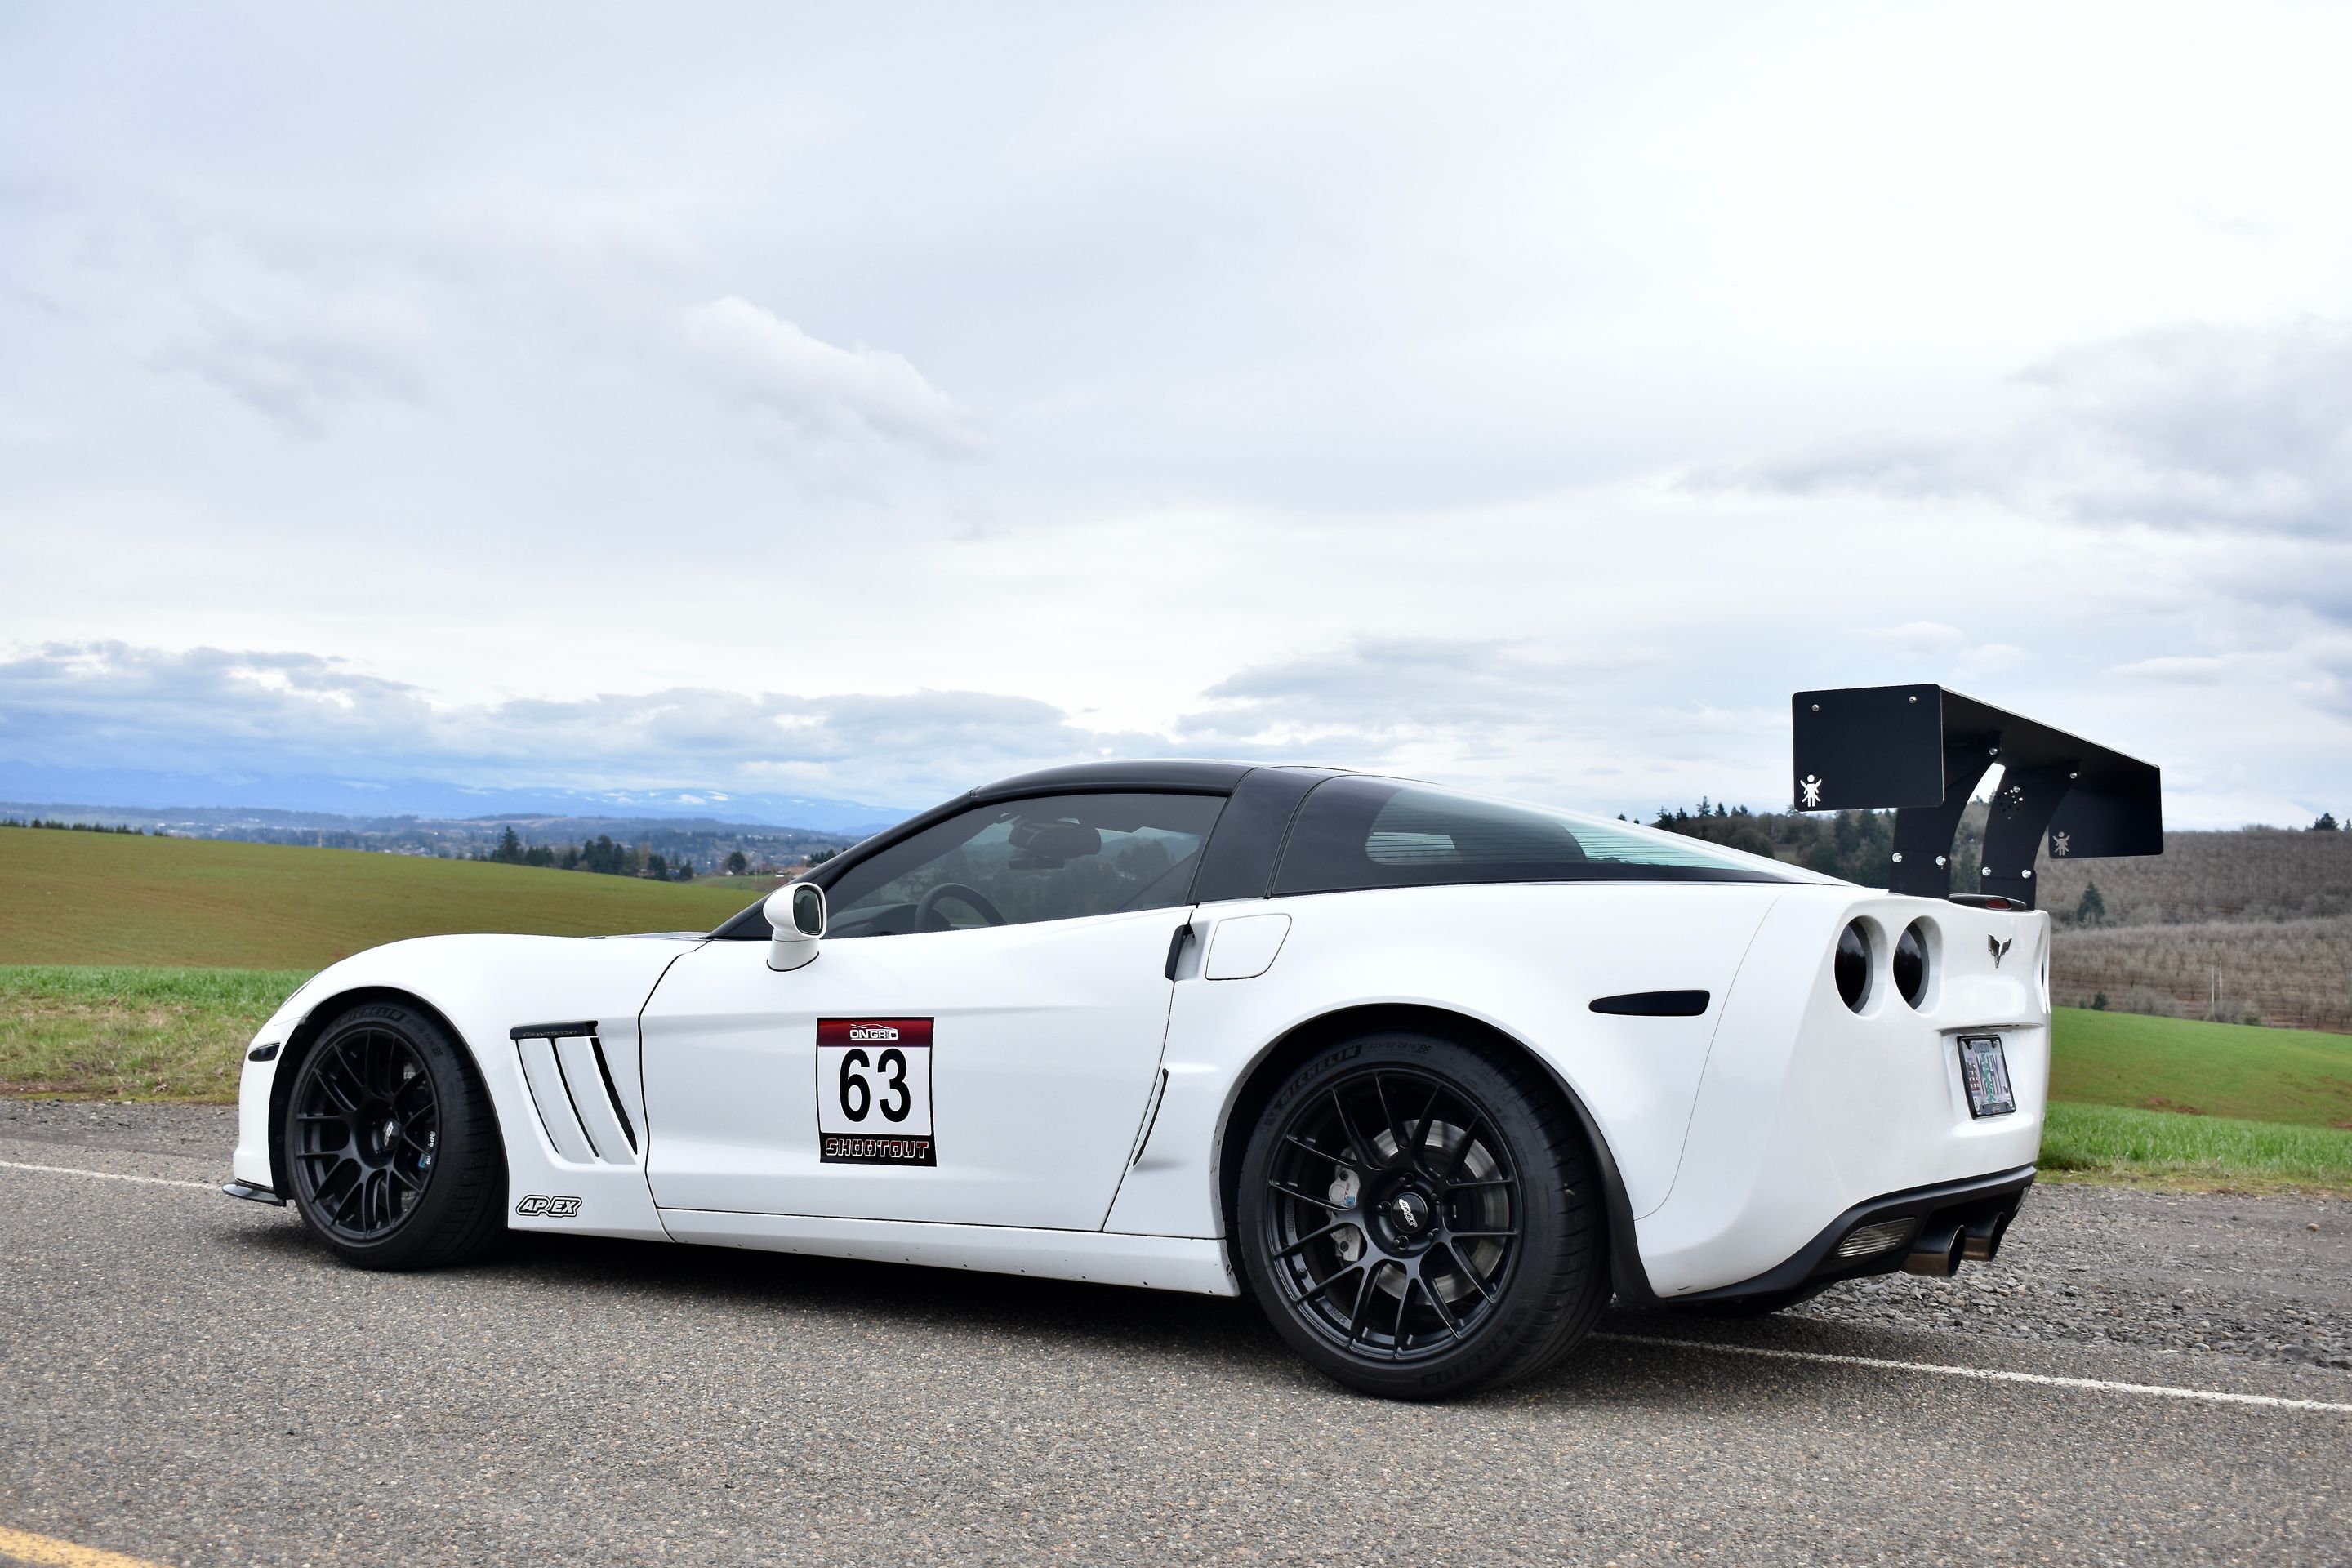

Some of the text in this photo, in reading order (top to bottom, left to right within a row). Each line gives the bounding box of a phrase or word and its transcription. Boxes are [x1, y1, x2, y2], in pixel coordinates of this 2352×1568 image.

[840, 1048, 911, 1123] 63
[1280, 1045, 1359, 1105] MICHELIN
[826, 1138, 929, 1159] SHOOTOUT
[519, 1197, 579, 1214] APEX
